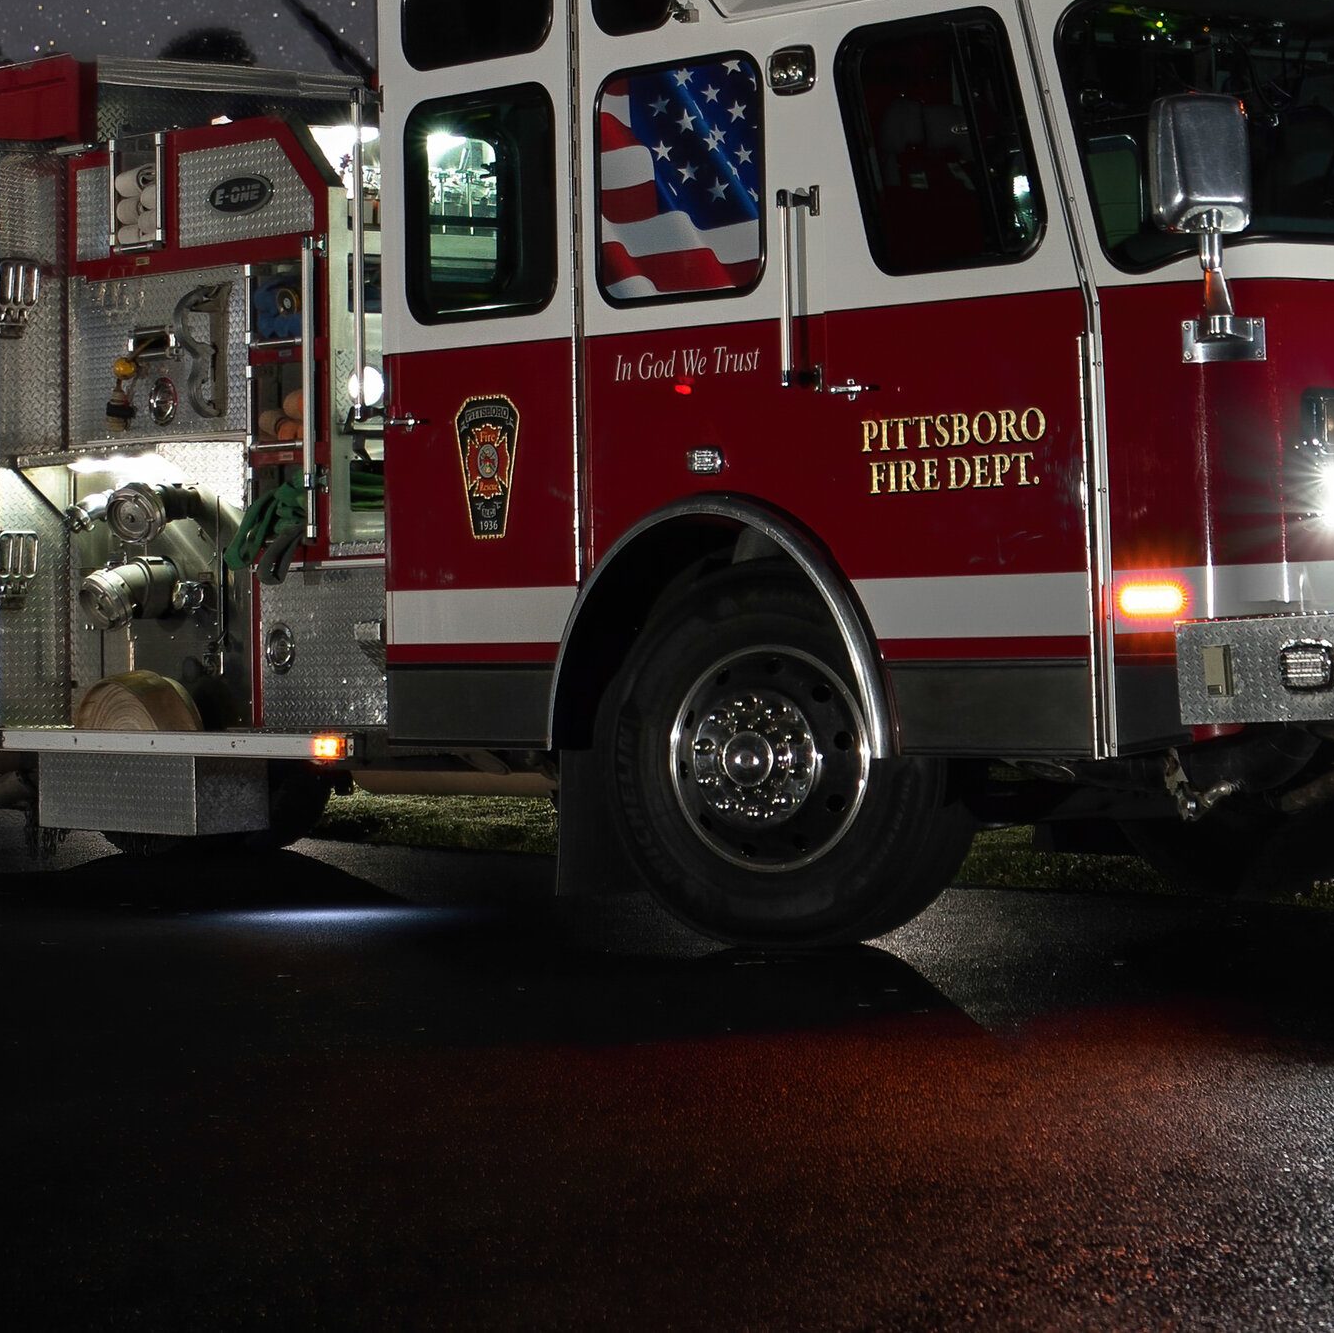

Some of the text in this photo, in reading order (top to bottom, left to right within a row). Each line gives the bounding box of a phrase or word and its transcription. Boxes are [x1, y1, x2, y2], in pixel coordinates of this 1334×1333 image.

[215, 183, 260, 206] E-ONE
[615, 346, 761, 382] In God We Trust
[467, 407, 508, 421] PITTSBORO
[479, 432, 495, 443] Fire
[861, 407, 1046, 452] PITTSBORO
[869, 452, 1040, 494] FIRE DEPT.
[479, 520, 498, 531] 1936
